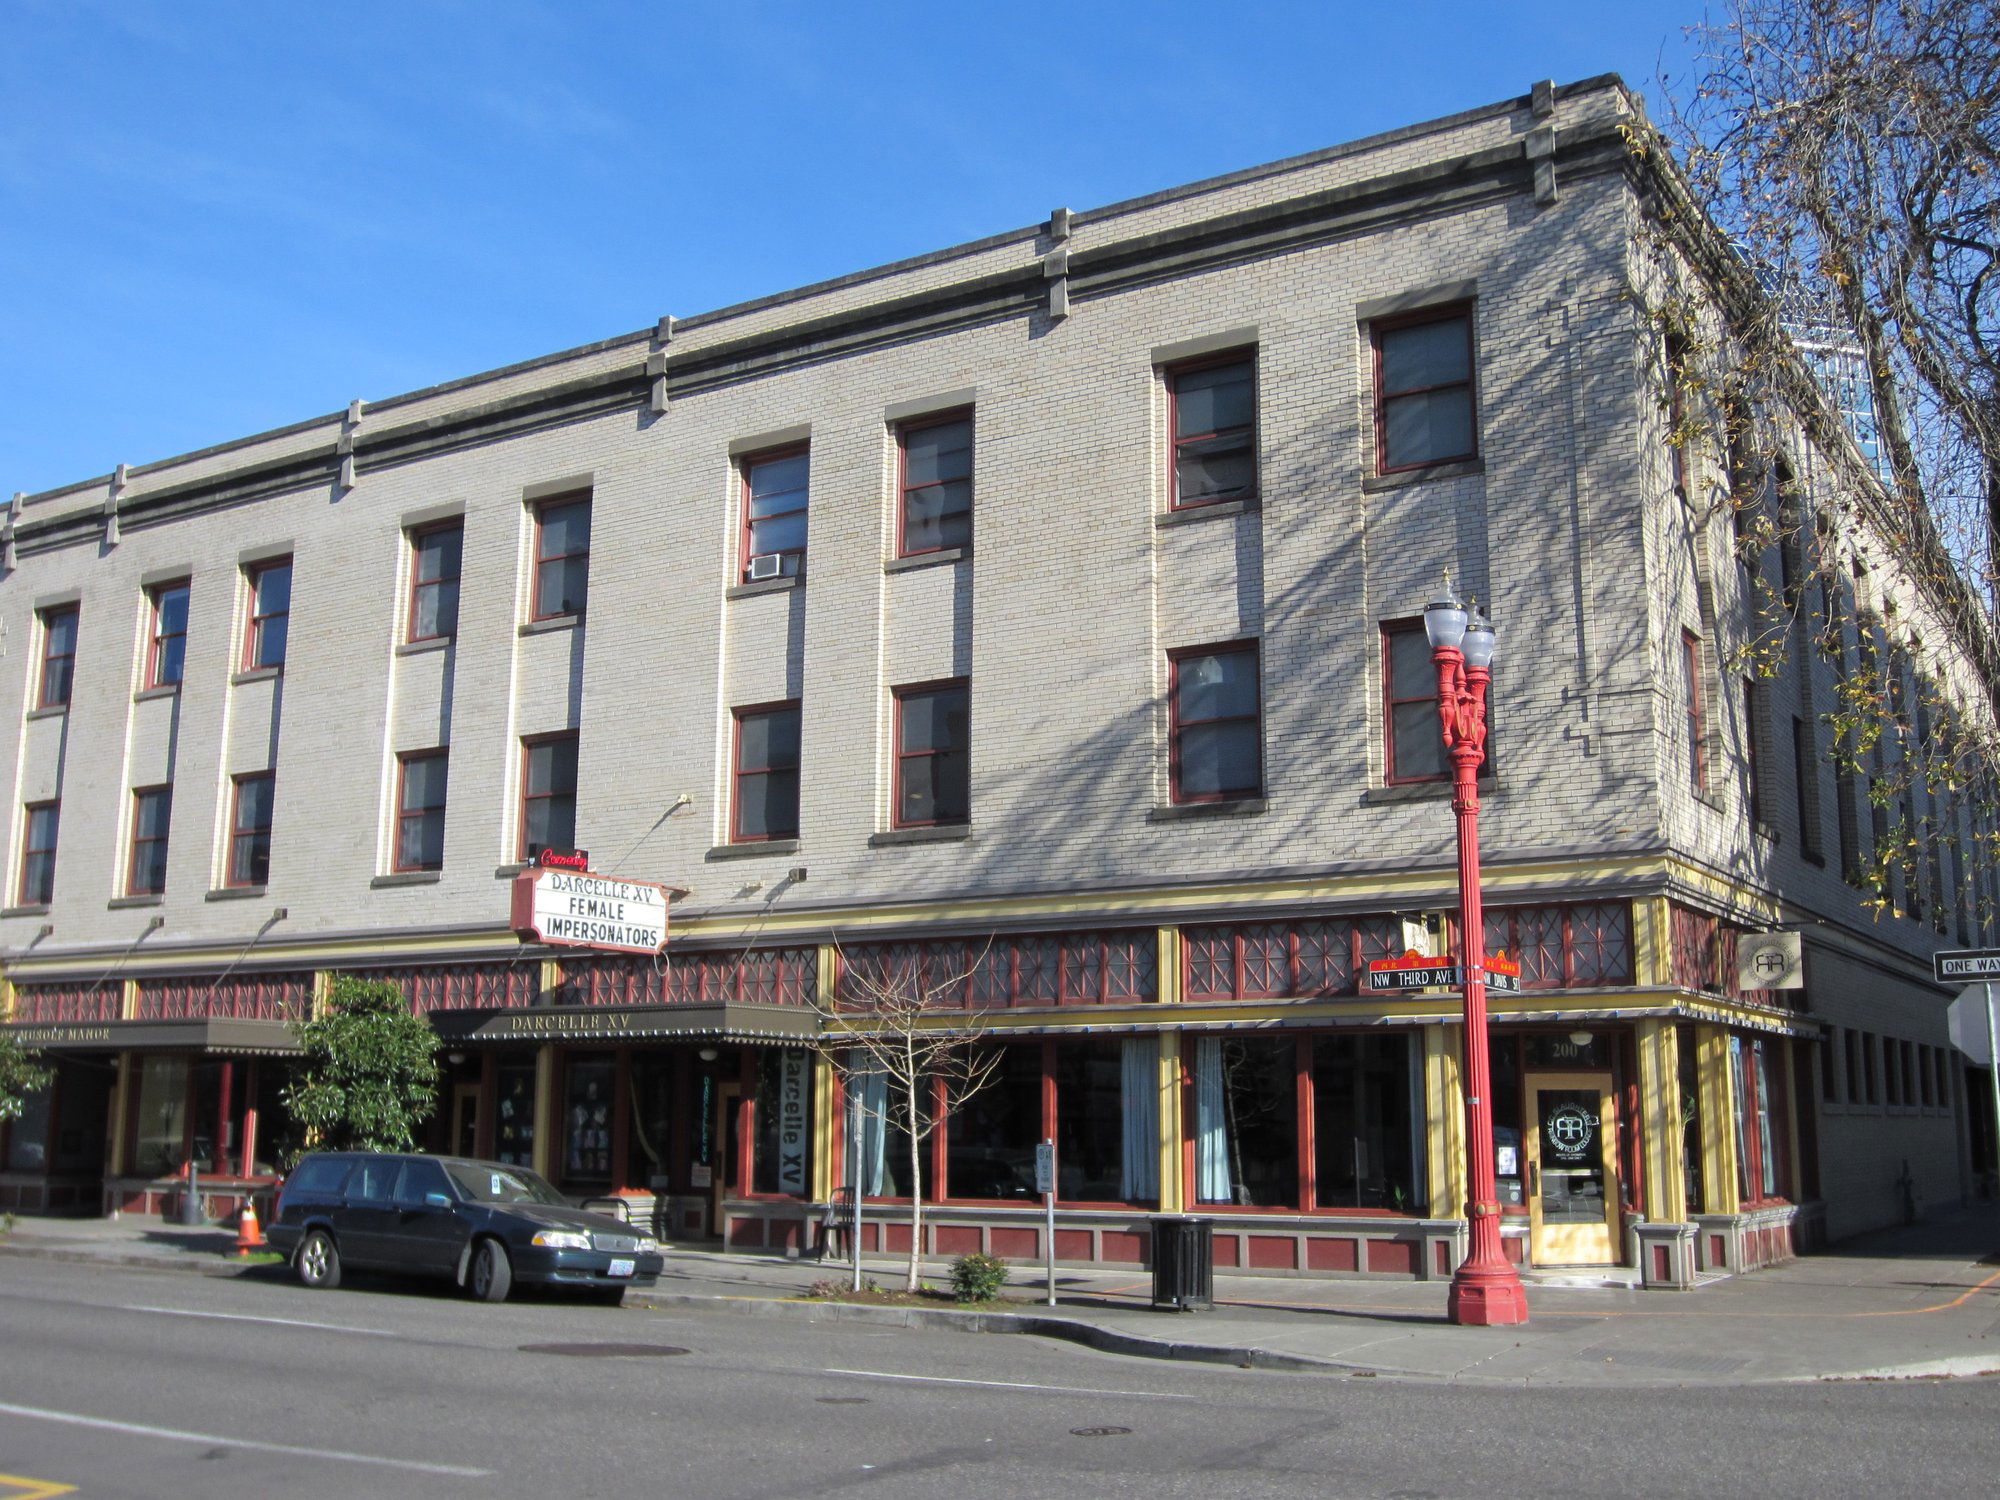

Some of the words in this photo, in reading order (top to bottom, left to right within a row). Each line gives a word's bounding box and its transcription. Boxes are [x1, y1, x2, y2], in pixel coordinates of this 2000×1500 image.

[551, 873, 629, 900] DARCELLE
[633, 887, 653, 903] XV
[569, 897, 624, 920] FEMALE
[547, 917, 657, 947] IMPERSONATORS
[1945, 960, 1972, 973] ONE
[1374, 973, 1390, 987] NW
[1398, 970, 1429, 987] THIRD
[1434, 970, 1454, 984] AVE
[1494, 972, 1508, 989] DAVIS
[512, 1014, 599, 1031] DARCELLE
[607, 1014, 630, 1030] XV
[68, 1027, 110, 1041] MANOR
[1552, 1042, 1578, 1058] 200
[783, 1047, 805, 1145] Darcelle
[782, 1153, 802, 1185] XV
